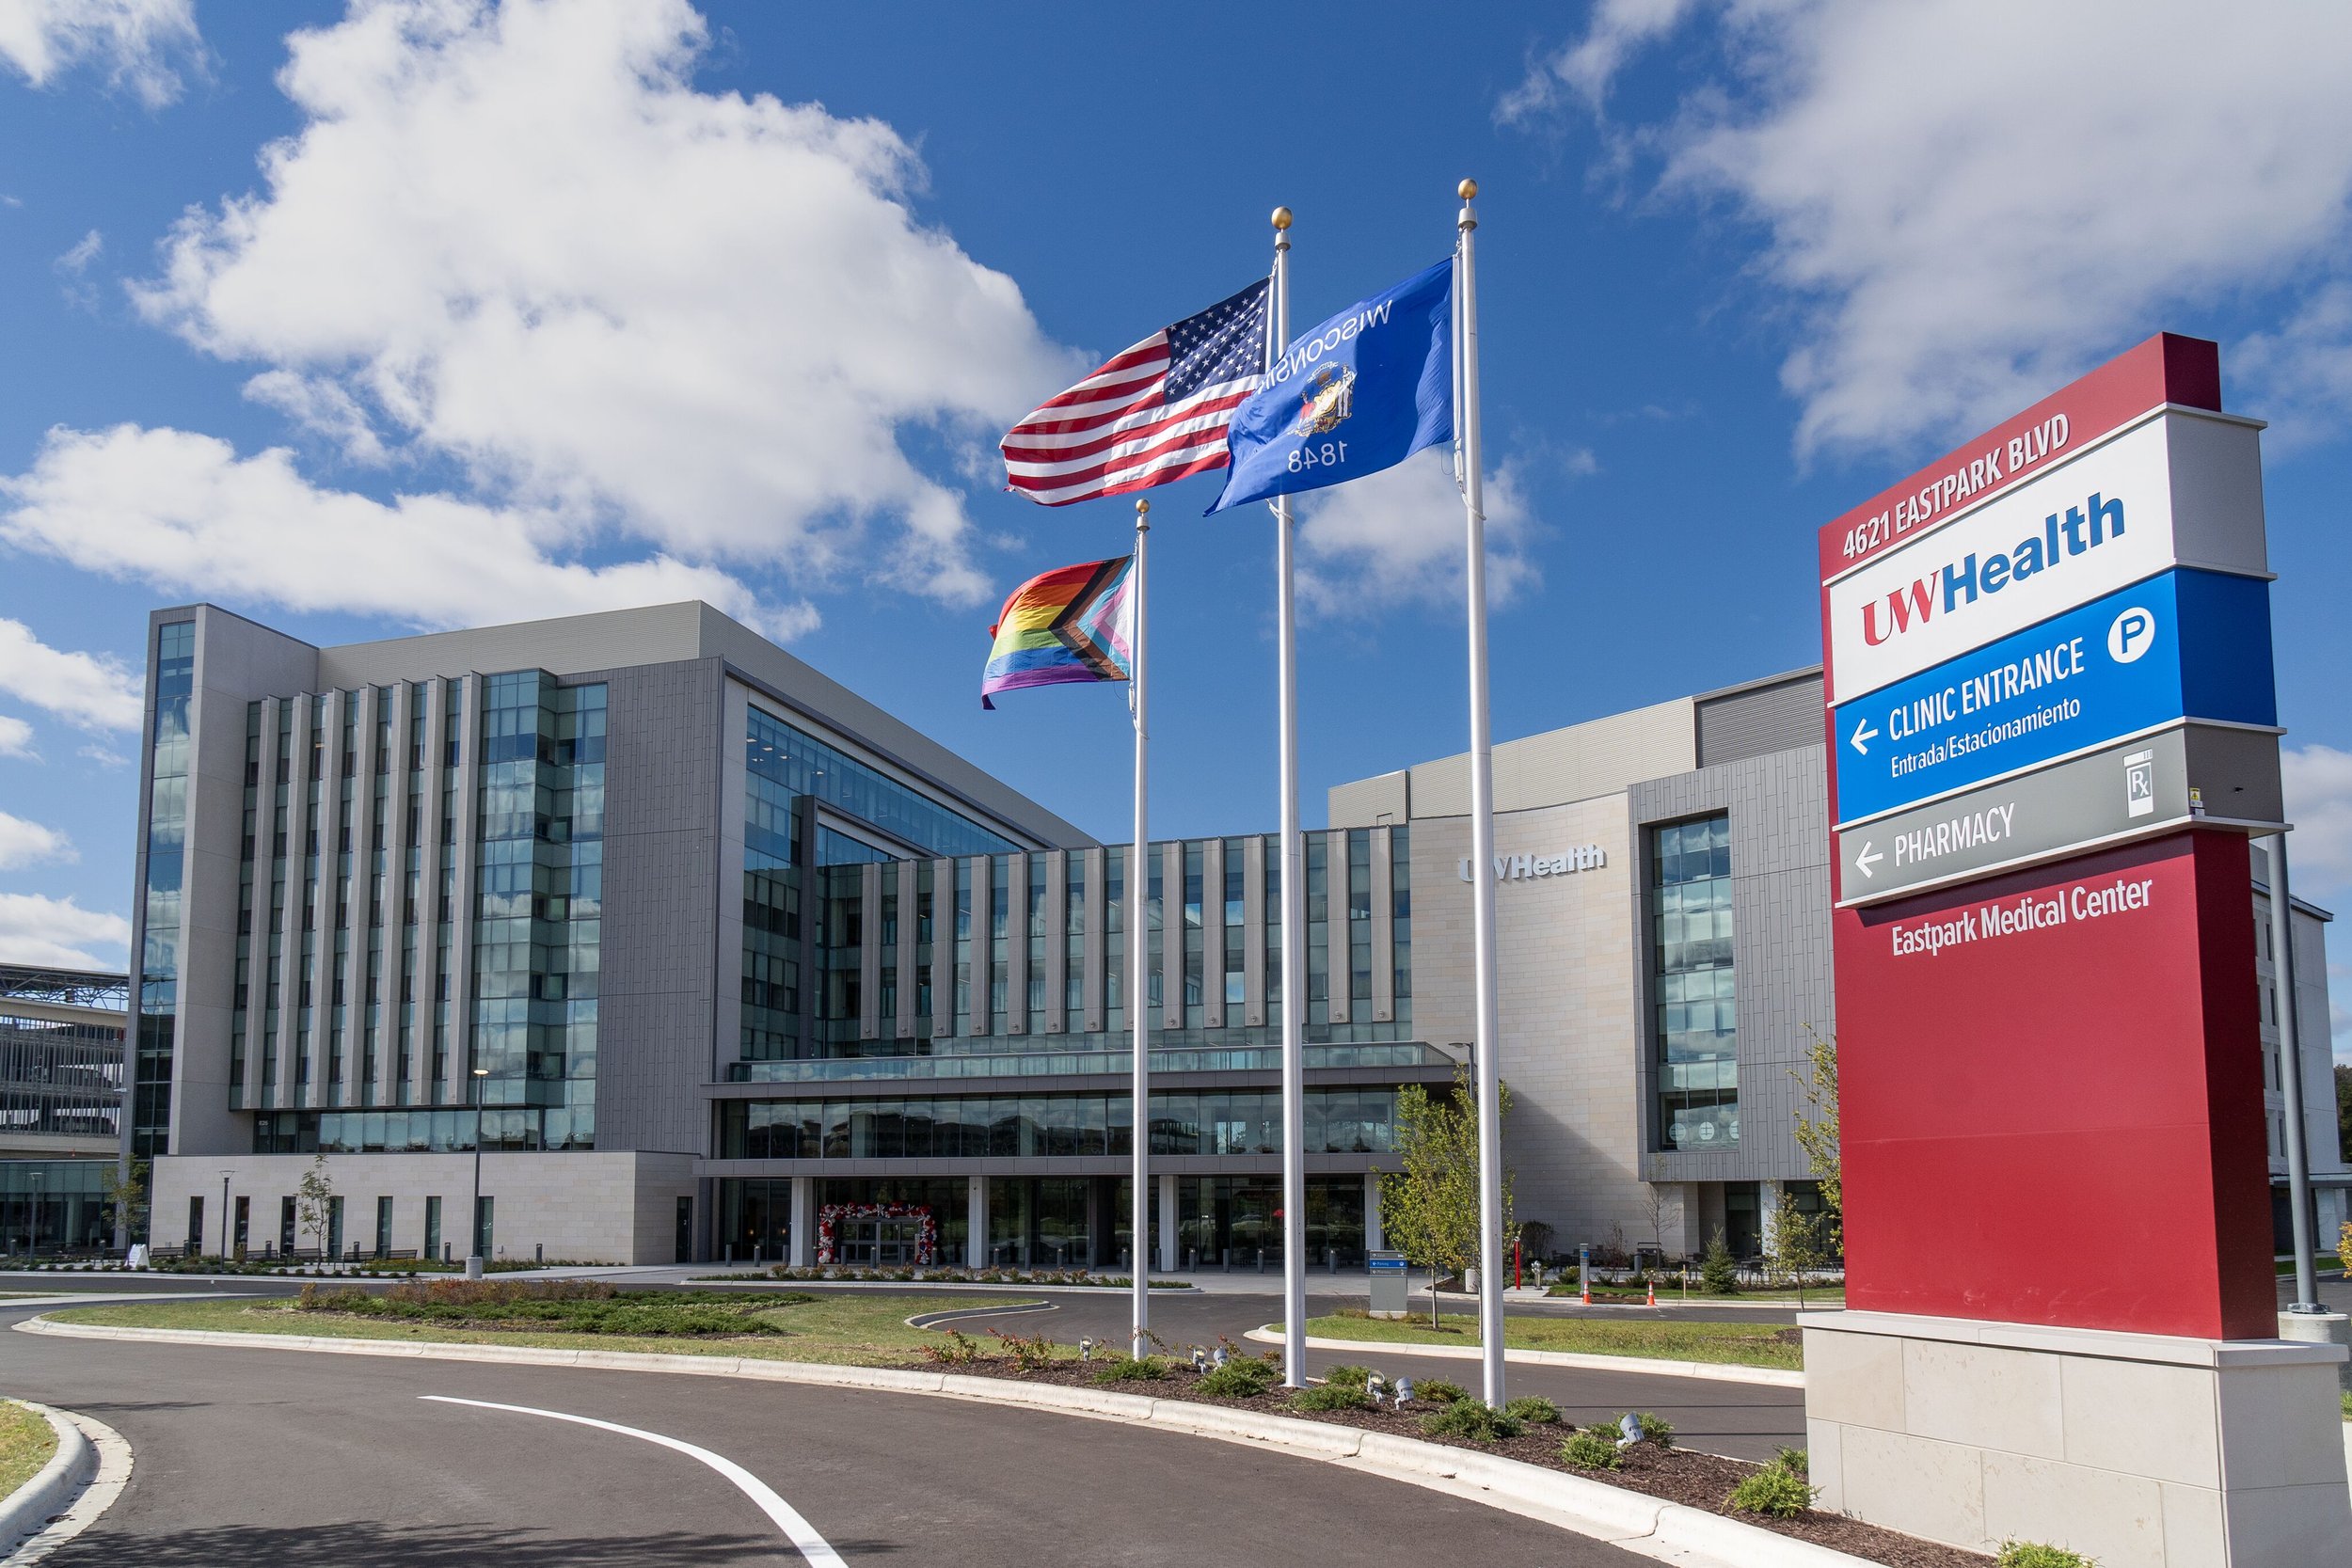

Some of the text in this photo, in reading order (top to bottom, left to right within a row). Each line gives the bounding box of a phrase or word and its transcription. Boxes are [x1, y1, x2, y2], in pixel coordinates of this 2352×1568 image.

[1842, 412, 2070, 559] 4621 EASTPARK BLVD
[2121, 614, 2146, 654] P
[1888, 637, 2085, 741] CLINIC ENTRANCE
[1891, 698, 2081, 778] Entrada/Estacionamiento
[1895, 802, 2015, 867] PHARMACY
[1892, 879, 2153, 957] Eastpark Medical Center
